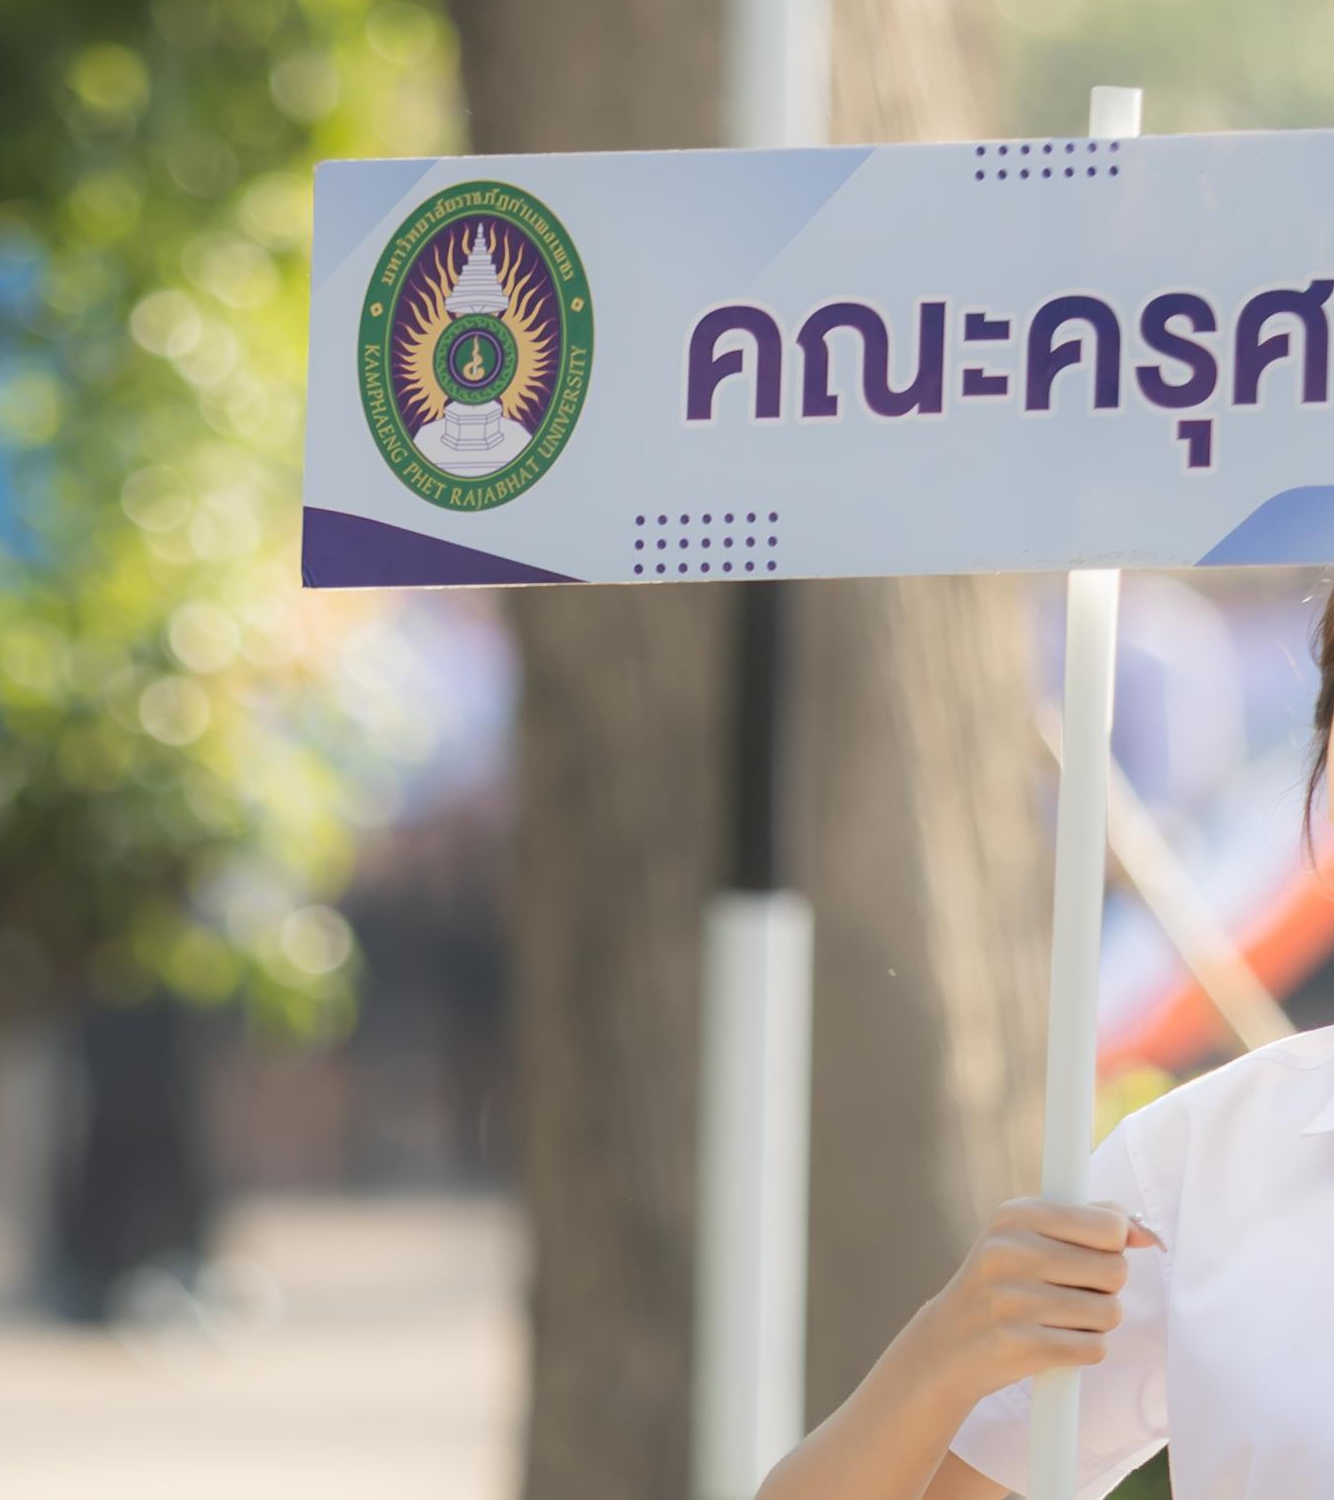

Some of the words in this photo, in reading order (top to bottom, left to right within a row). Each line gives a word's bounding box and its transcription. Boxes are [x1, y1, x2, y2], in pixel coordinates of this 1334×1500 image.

[363, 344, 409, 464] KAMPHAENG
[403, 461, 448, 500] PHET
[449, 455, 541, 510] RAJABHAT
[538, 345, 588, 460] UNIVERSITY
